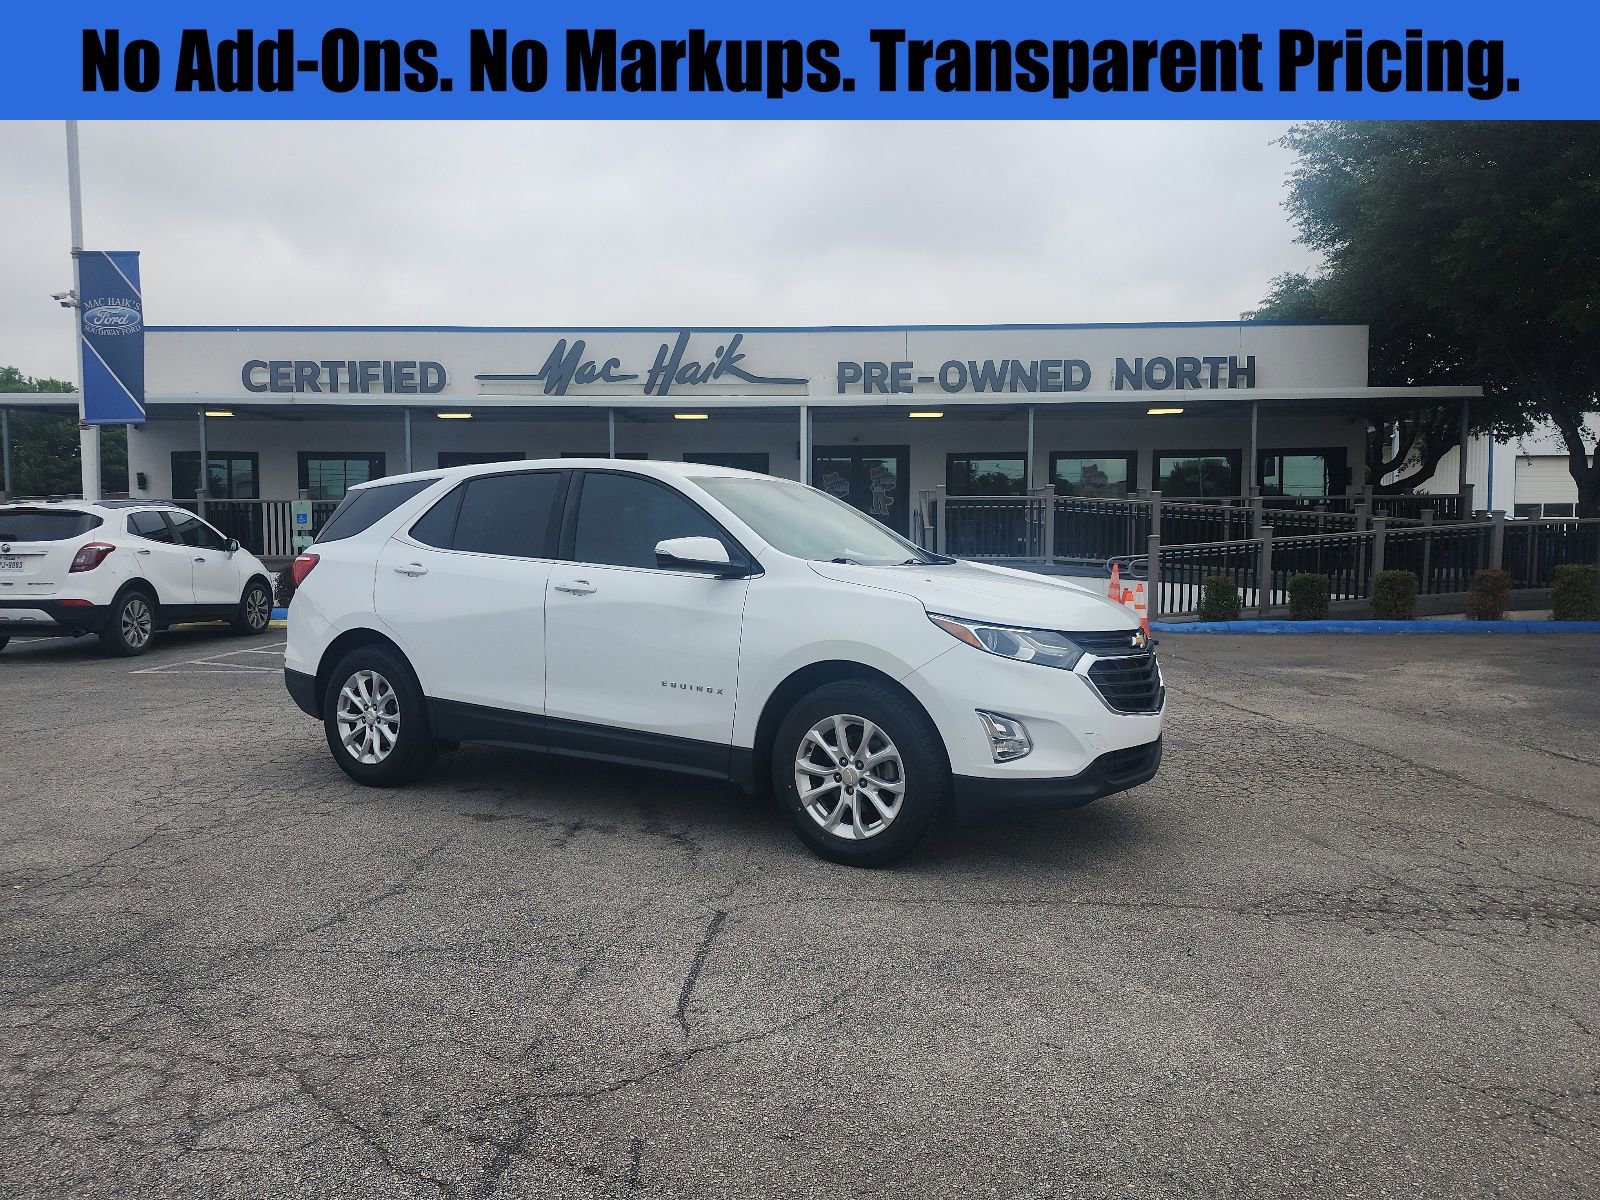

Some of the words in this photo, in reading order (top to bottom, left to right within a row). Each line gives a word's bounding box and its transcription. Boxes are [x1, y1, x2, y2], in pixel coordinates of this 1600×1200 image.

[84, 297, 105, 310] MAC
[108, 297, 141, 311] HAIK'S
[94, 310, 129, 325] Ford
[122, 325, 141, 335] FORD
[643, 329, 811, 396] Haik
[241, 360, 448, 394] CERTIFIED
[837, 359, 1092, 394] PRE-OWNED
[1111, 356, 1258, 391] NORTH
[661, 680, 723, 695] EQUINOX
